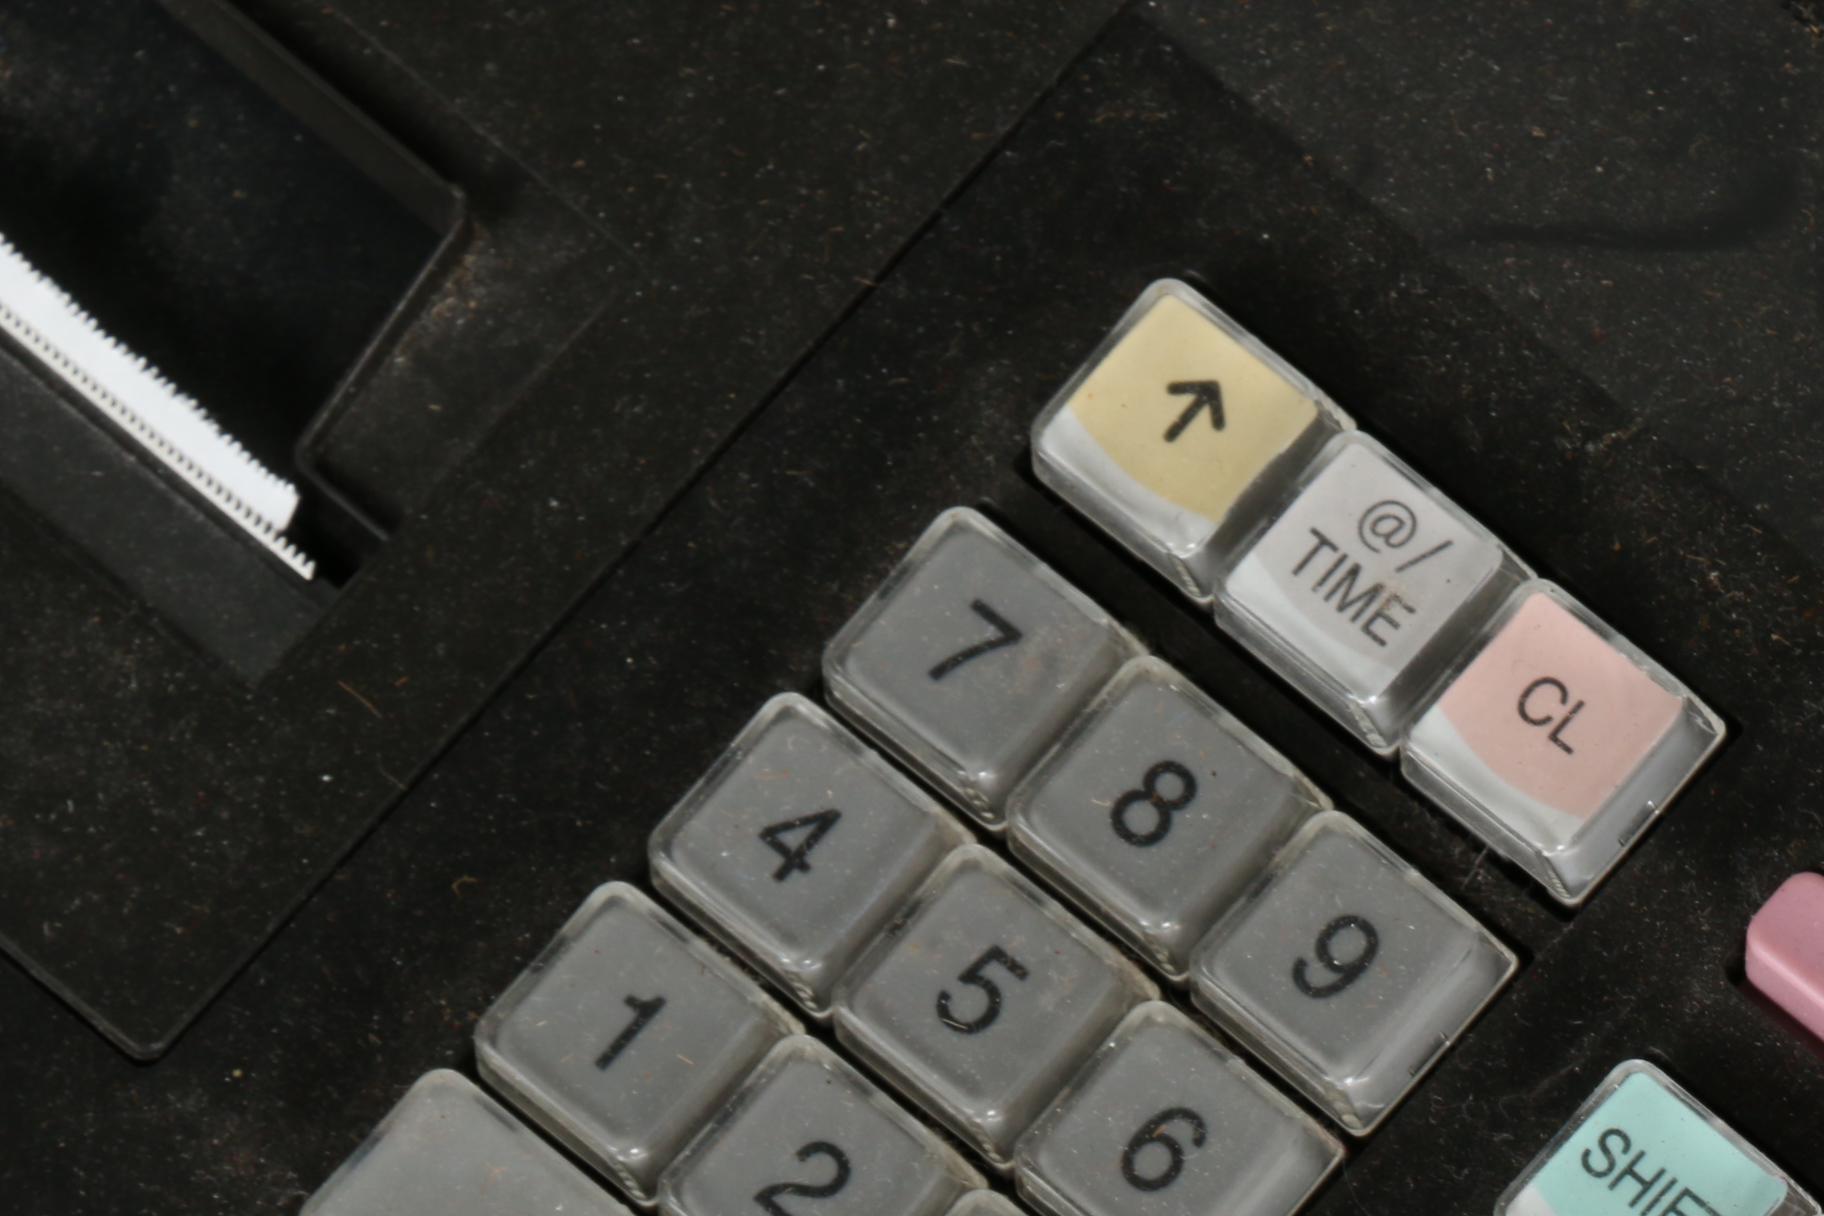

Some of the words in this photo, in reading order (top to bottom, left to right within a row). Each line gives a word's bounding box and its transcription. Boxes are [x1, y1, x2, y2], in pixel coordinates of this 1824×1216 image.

[1357, 500, 1454, 574] @/
[1291, 528, 1416, 648] TIME
[927, 599, 1023, 681] 7
[1516, 676, 1592, 755] CL
[1110, 760, 1197, 847] 8
[758, 809, 841, 883] 4
[936, 945, 1030, 1035] 5
[1293, 914, 1380, 999] 9
[594, 994, 667, 1071] 1
[1121, 1107, 1207, 1192] 6
